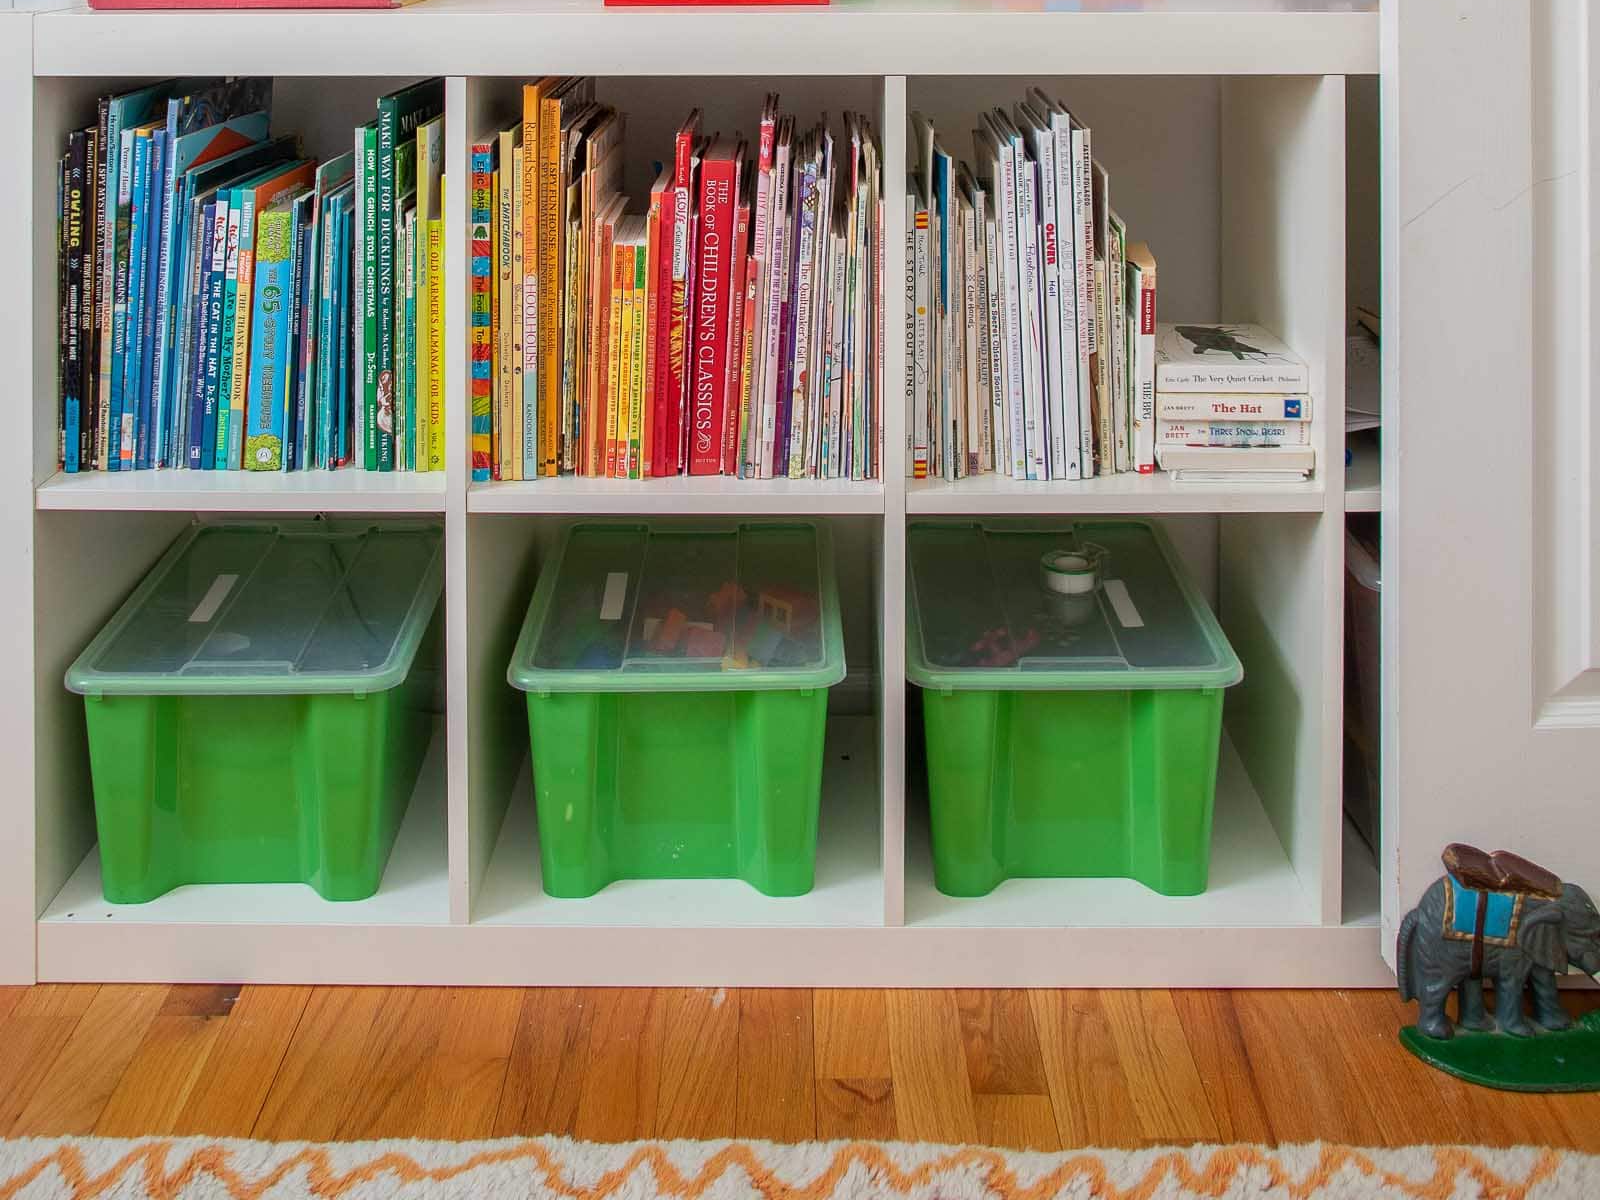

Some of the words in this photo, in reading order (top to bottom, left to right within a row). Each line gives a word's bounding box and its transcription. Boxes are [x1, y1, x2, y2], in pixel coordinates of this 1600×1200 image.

[382, 111, 391, 149] MAKE
[525, 122, 536, 163] Richard
[109, 115, 117, 173] Herman/Santoro
[382, 155, 391, 181] WAY
[548, 169, 557, 185] SPY
[382, 186, 391, 211] FOR
[525, 166, 536, 206] Scarry's
[706, 180, 716, 211] BOOK
[718, 180, 728, 204] THE
[71, 190, 80, 247] OWLING
[97, 188, 106, 236] MYSTERY:
[477, 189, 485, 223] CARLE
[676, 190, 687, 224] ELOISE
[242, 201, 252, 238] Willems
[525, 216, 536, 243] Great
[548, 213, 556, 251] HOUSE:
[705, 214, 715, 230] OF
[502, 202, 510, 267] SNATCHABOOK
[1046, 223, 1055, 265] OLIVER
[381, 219, 391, 294] DUCKLINGS
[524, 248, 536, 264] Big
[268, 268, 276, 283] THE
[802, 262, 812, 280] The
[213, 280, 221, 298] THE
[367, 266, 375, 317] CHRISTMAS
[548, 287, 555, 295] of
[700, 232, 719, 341] CHILDREN'S
[211, 302, 220, 321] CAT
[226, 291, 235, 309] Are
[477, 294, 485, 327] Foolish
[95, 302, 103, 328] Riddles
[224, 315, 233, 333] You
[525, 267, 537, 369] SCHOOLHOUSE
[798, 283, 809, 344] Quiltmaker's
[211, 324, 219, 334] IN
[236, 316, 247, 348] THANK
[210, 338, 218, 354] THE
[222, 336, 233, 352] My
[381, 333, 389, 369] McCloskey
[431, 328, 439, 375] ALMANAC
[477, 330, 485, 369] Tortoise
[797, 346, 806, 364] Gift
[992, 340, 1000, 373] Chicken
[209, 358, 217, 378] HAT
[234, 352, 244, 371] YOU
[367, 352, 375, 364] Dr.
[221, 356, 232, 400] Mother?
[233, 372, 242, 400] BOOK
[367, 364, 375, 383] Seuss
[1192, 375, 1207, 383] The
[1209, 375, 1224, 384] Very
[1227, 375, 1246, 384] Quiet
[207, 385, 215, 396] Dr.
[696, 346, 714, 430] CLASSICS
[1143, 381, 1152, 400] THE
[205, 397, 215, 415] Seuss
[431, 402, 439, 425] KIDS
[1143, 401, 1152, 420] BFG
[1212, 404, 1236, 413] The
[1240, 404, 1262, 413] Hat
[217, 409, 229, 450] Eastman
[1209, 427, 1233, 436] THREE
[1236, 427, 1258, 436] SNOW
[1261, 427, 1285, 436] BEARS
[381, 433, 389, 462] VIKING
